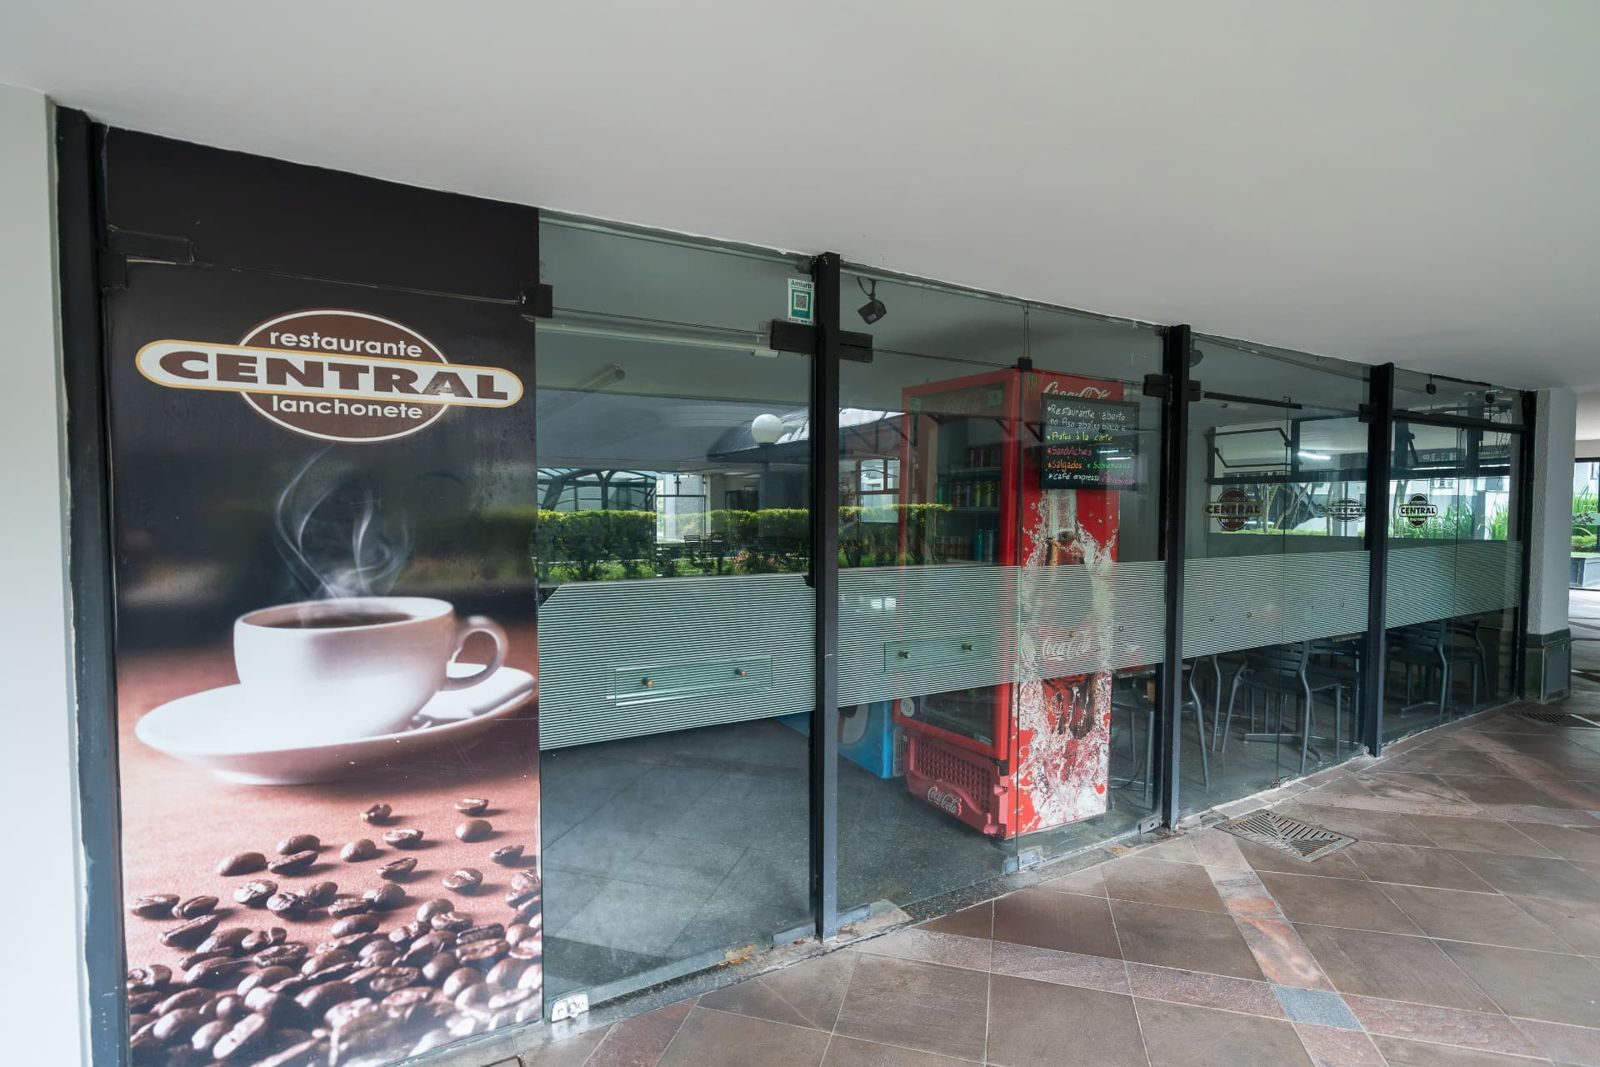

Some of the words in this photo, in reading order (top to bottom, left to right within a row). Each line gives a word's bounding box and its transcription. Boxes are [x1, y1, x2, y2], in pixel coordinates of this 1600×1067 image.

[270, 328, 423, 359] restaurante
[159, 351, 508, 400] CENTRAL
[272, 395, 423, 420] lanchonete
[1205, 503, 1261, 514] CENTRAL
[1400, 507, 1436, 515] CENTRAL
